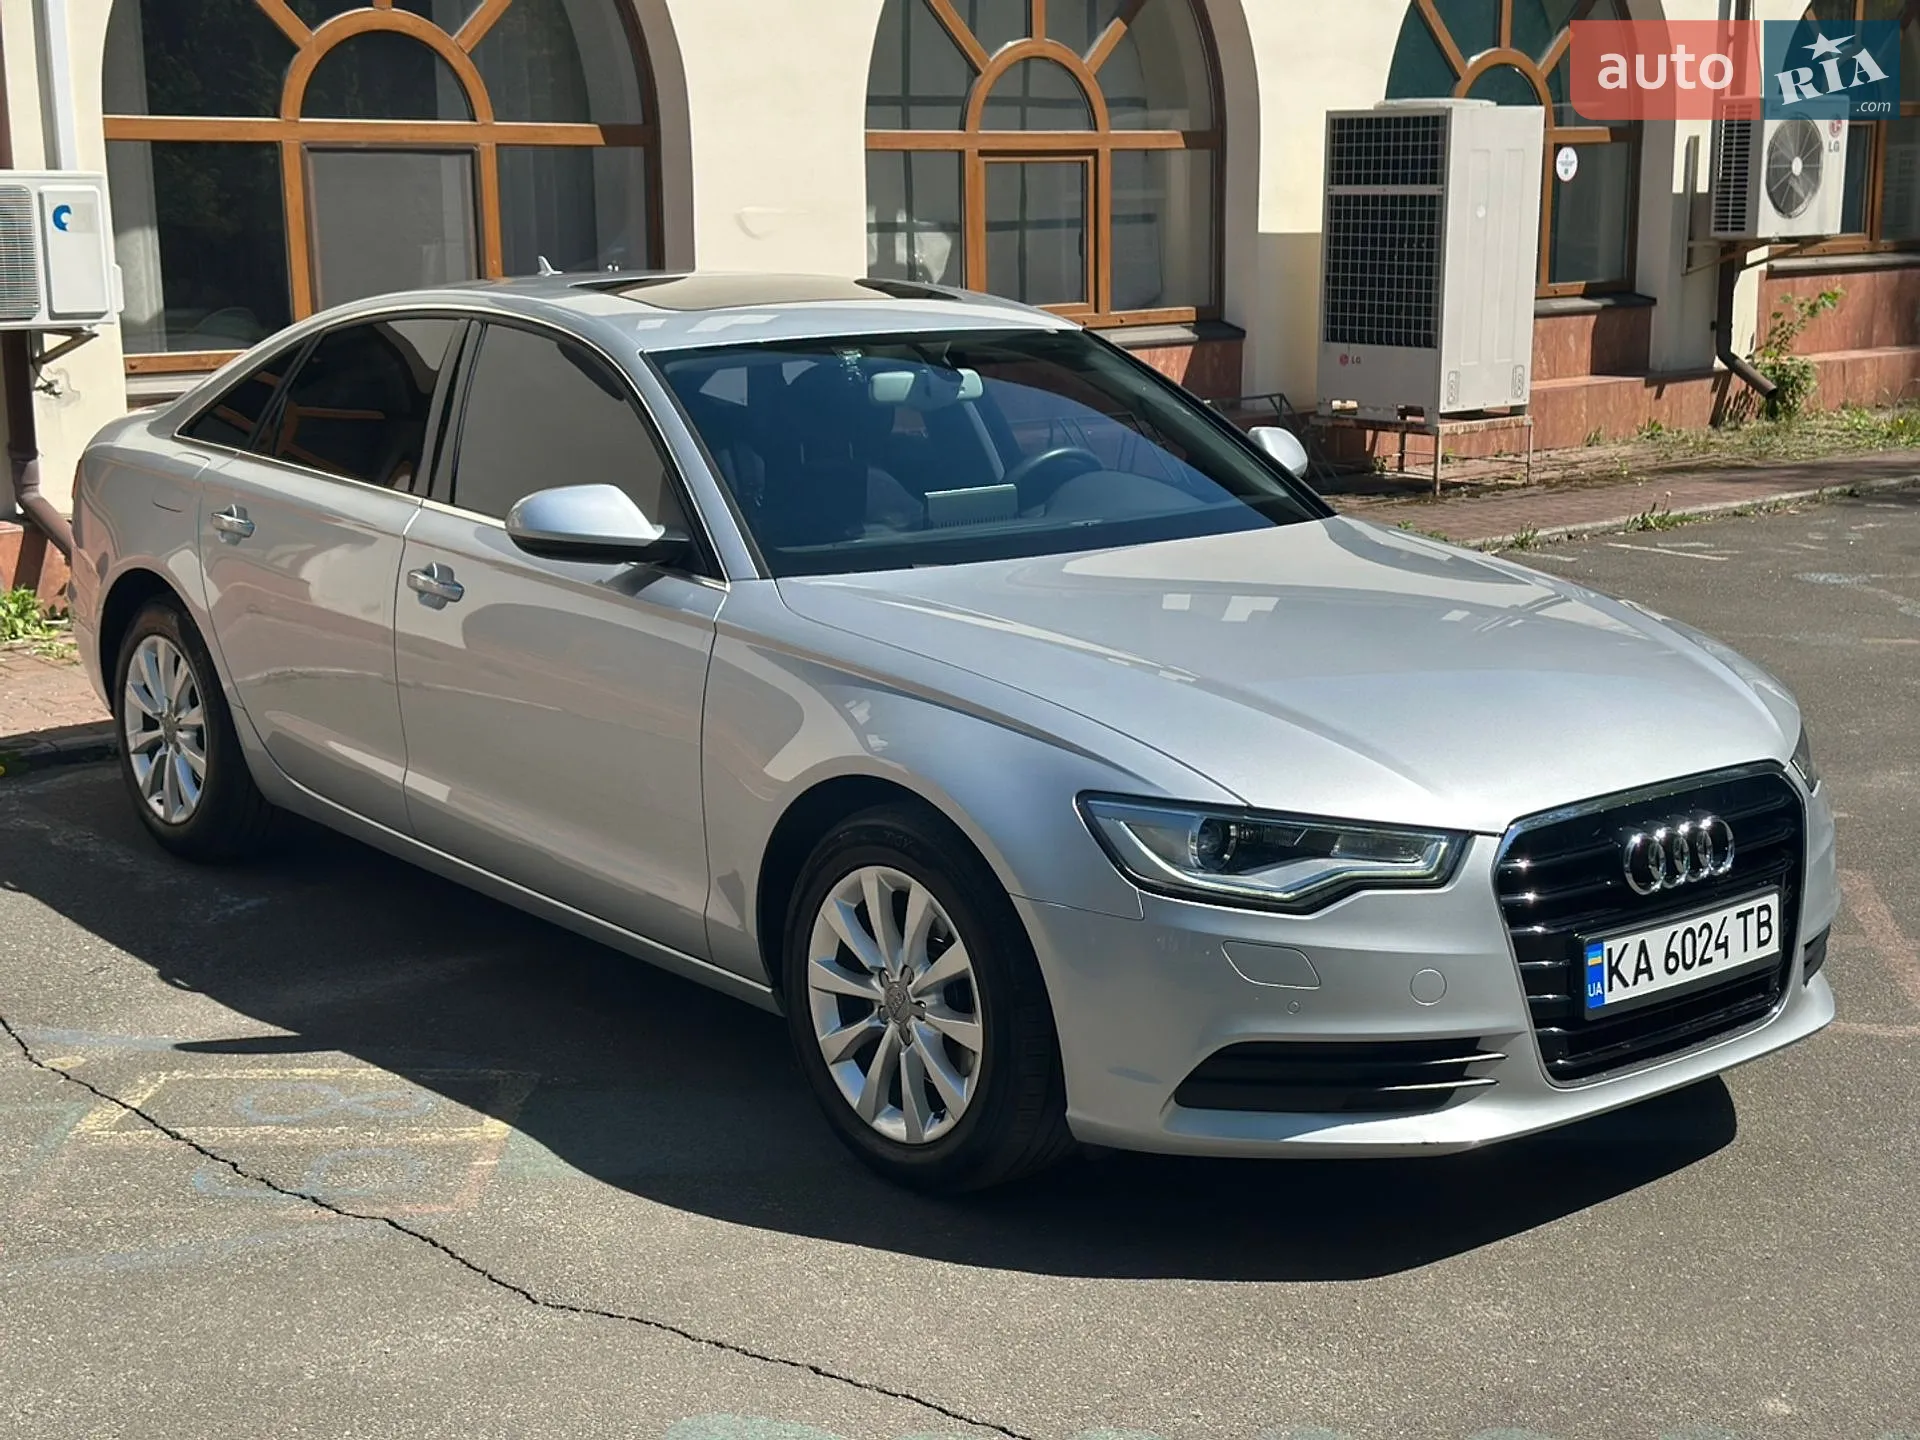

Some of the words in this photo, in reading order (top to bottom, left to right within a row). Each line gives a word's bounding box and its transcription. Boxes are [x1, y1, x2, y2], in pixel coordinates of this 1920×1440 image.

[1828, 140, 1840, 153] LG
[1351, 355, 1362, 365] LG
[1607, 939, 1655, 993] KA
[1664, 915, 1729, 976] 6024
[1736, 903, 1772, 953] TB
[1588, 984, 1604, 998] UA
